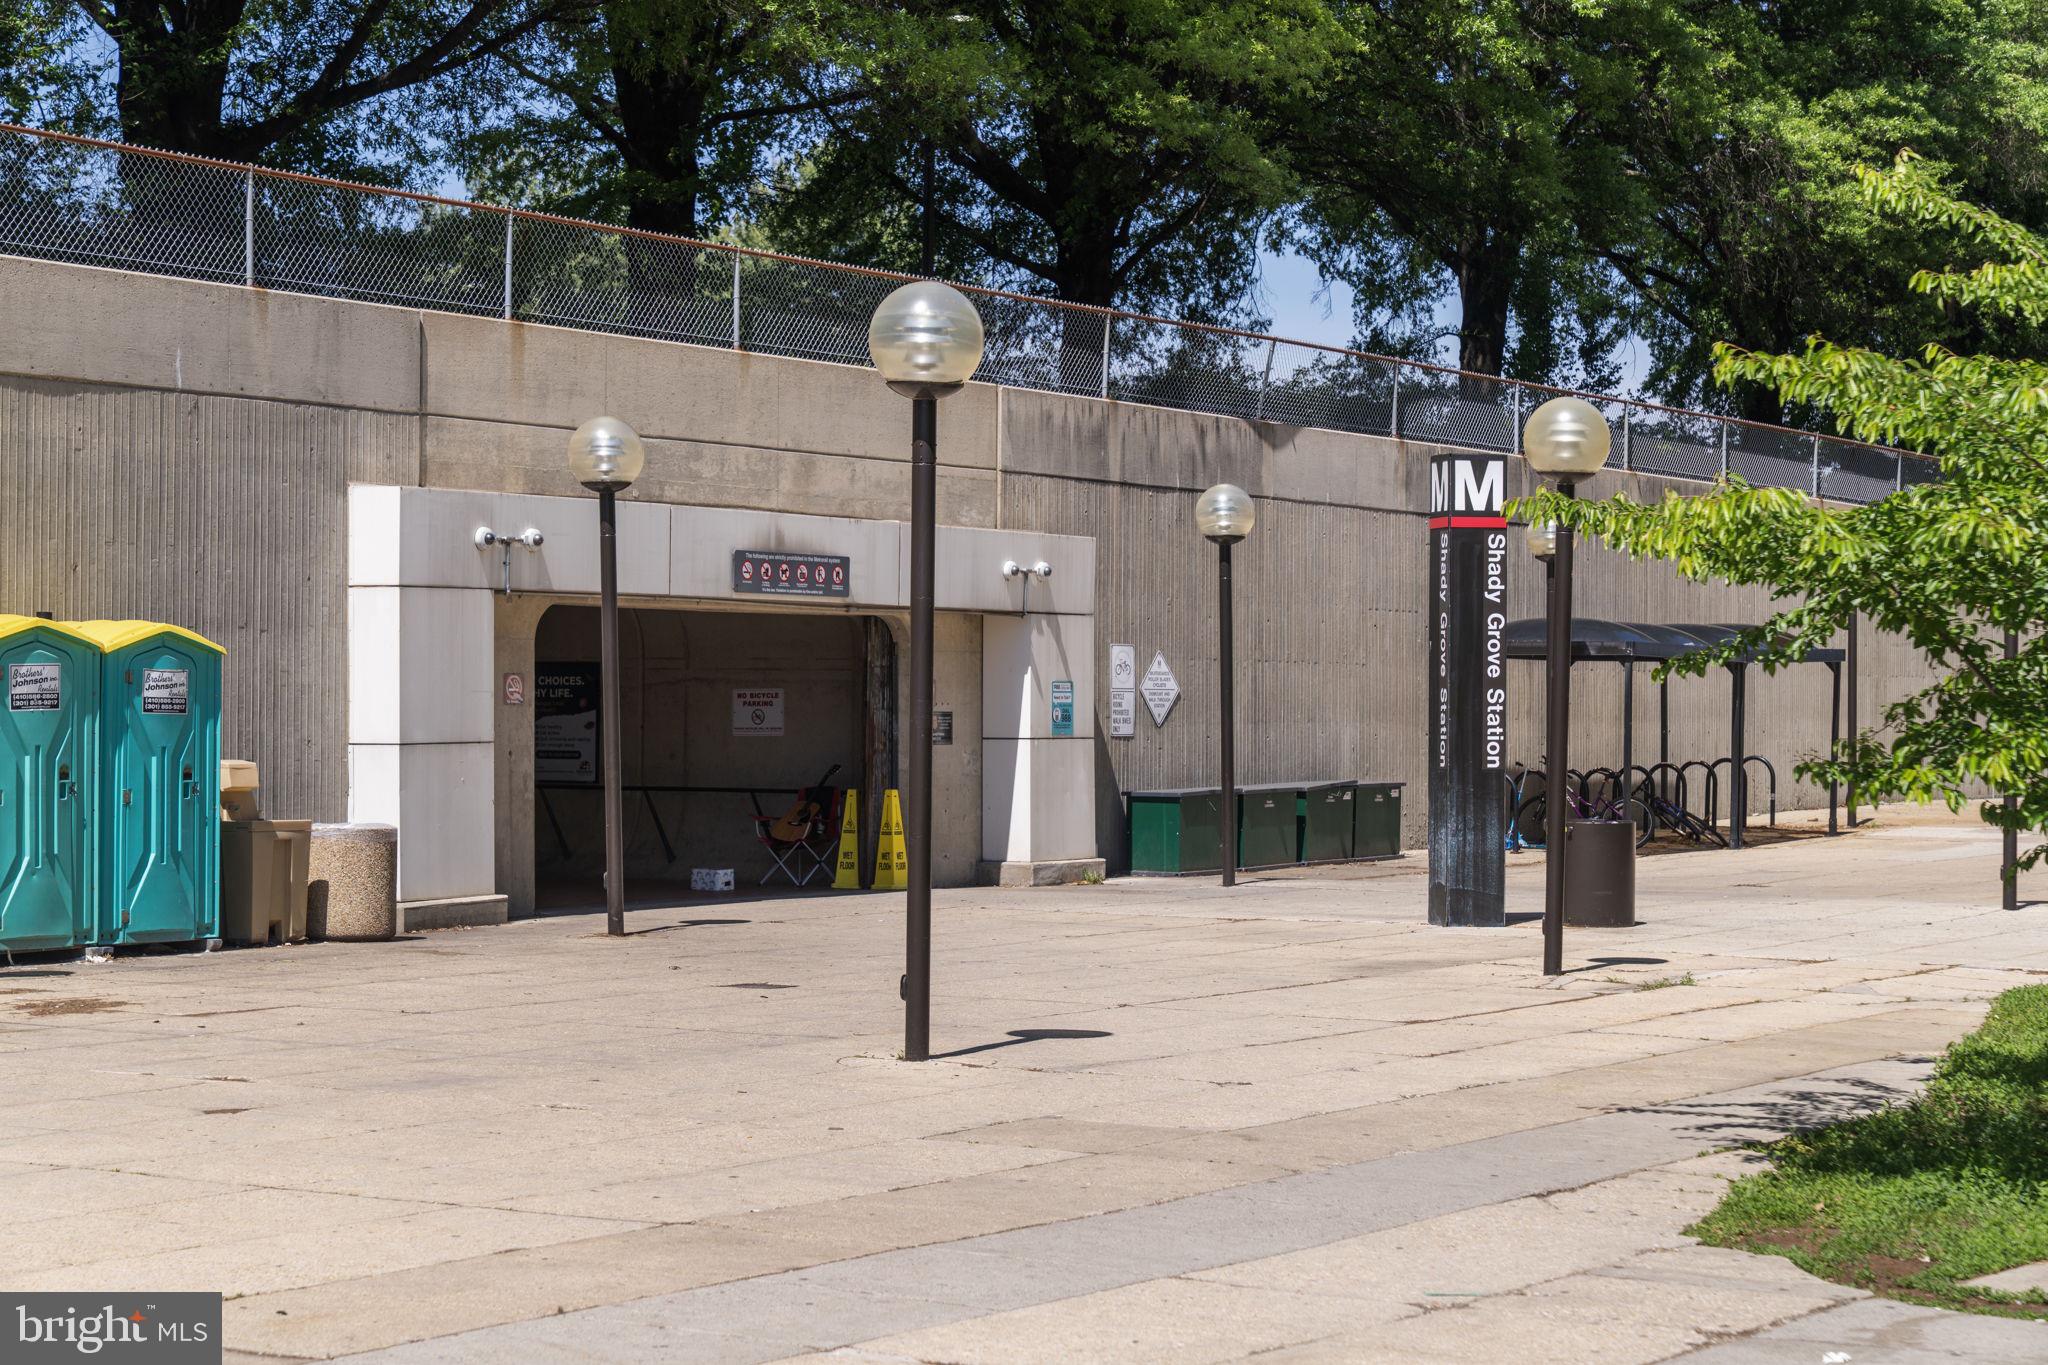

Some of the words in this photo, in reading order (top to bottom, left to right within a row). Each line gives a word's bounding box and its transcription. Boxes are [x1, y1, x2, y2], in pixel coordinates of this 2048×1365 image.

[1431, 461, 1448, 512] M
[1455, 460, 1503, 511] M
[1440, 533, 1448, 602] Shady
[1485, 533, 1506, 603] Shady
[1440, 612, 1448, 678] Grove
[1487, 613, 1505, 678] Grove
[13, 676, 49, 688] Johnson
[145, 682, 178, 691] Johnson
[539, 676, 585, 685] CHOICES.
[550, 689, 573, 697] LIFE.
[1440, 687, 1448, 767] Station
[1487, 688, 1505, 768] Station
[882, 852, 890, 860] WET
